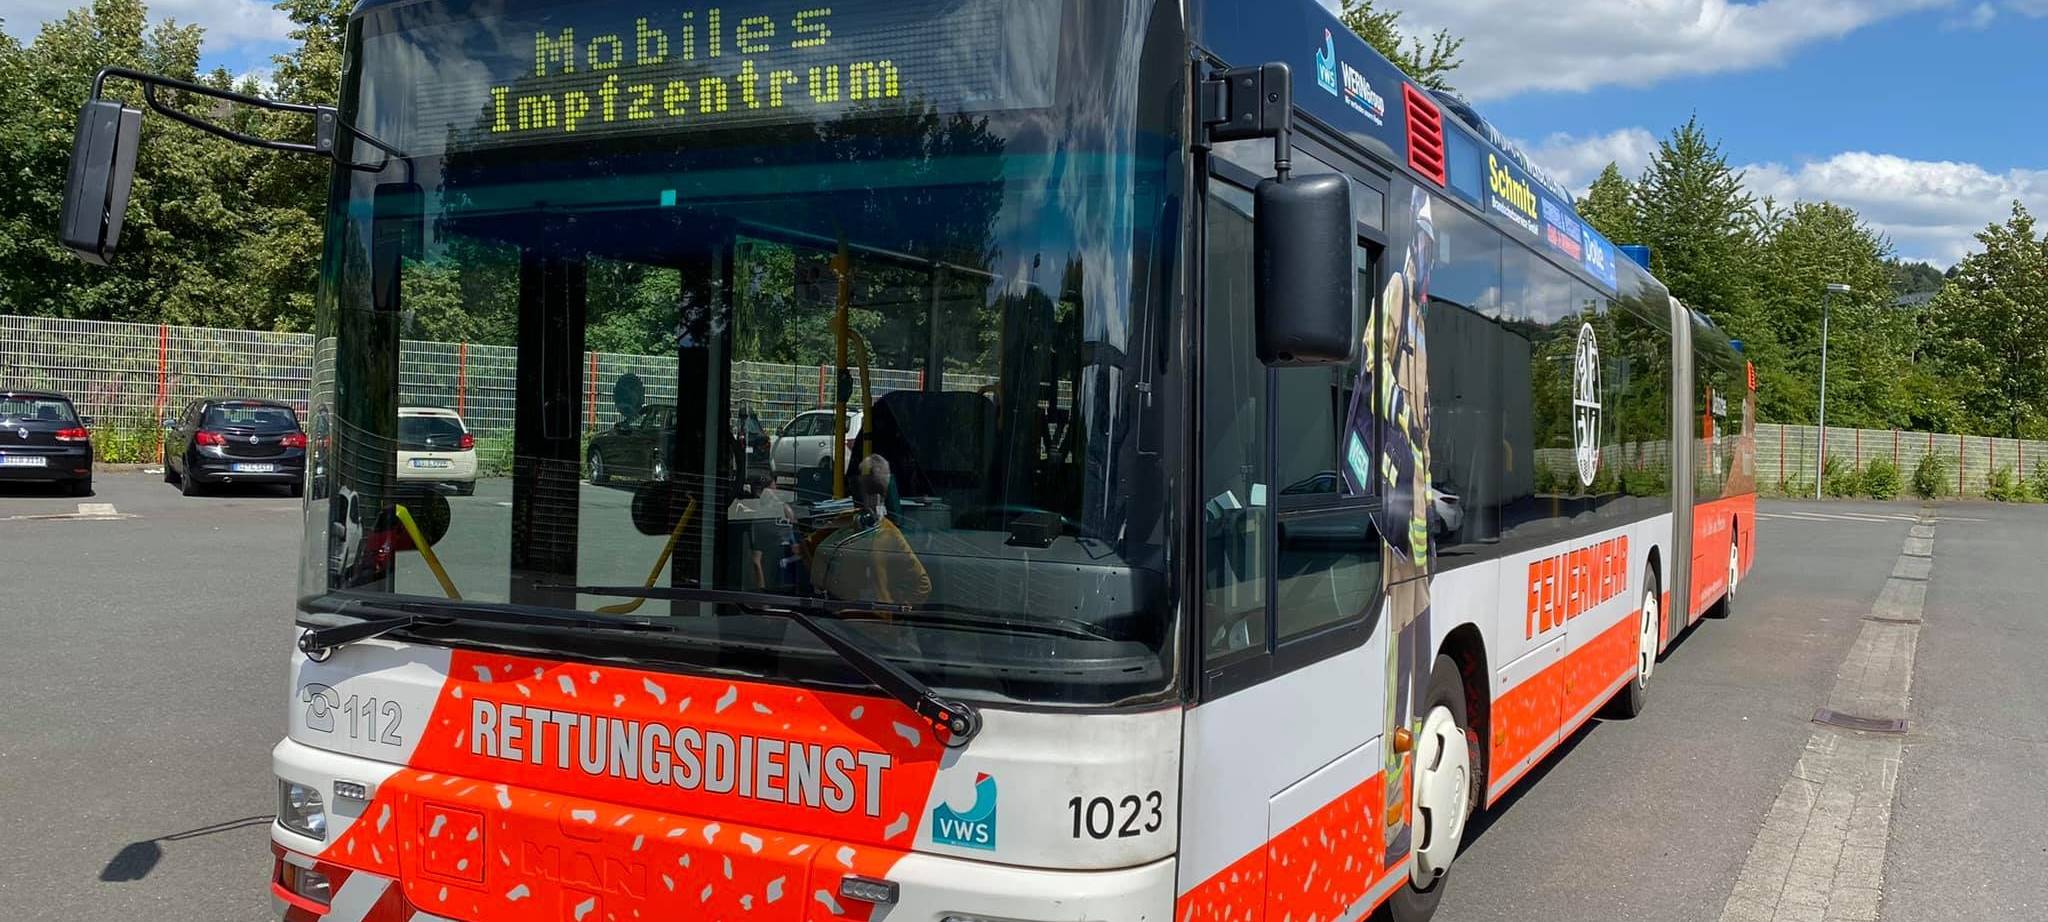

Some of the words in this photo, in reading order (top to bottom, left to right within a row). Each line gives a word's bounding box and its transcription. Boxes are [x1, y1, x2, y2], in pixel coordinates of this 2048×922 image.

[535, 7, 832, 77] Mobiles
[490, 59, 899, 132] Impfzentrum
[1489, 153, 1538, 220] Schmitz
[1526, 535, 1628, 641] FEUERWEHR
[344, 695, 402, 746] 112
[470, 698, 892, 818] RETTUNGSDIENST
[940, 817, 989, 844] VWS
[1068, 790, 1163, 840] 1023
[521, 840, 648, 900] MAN
